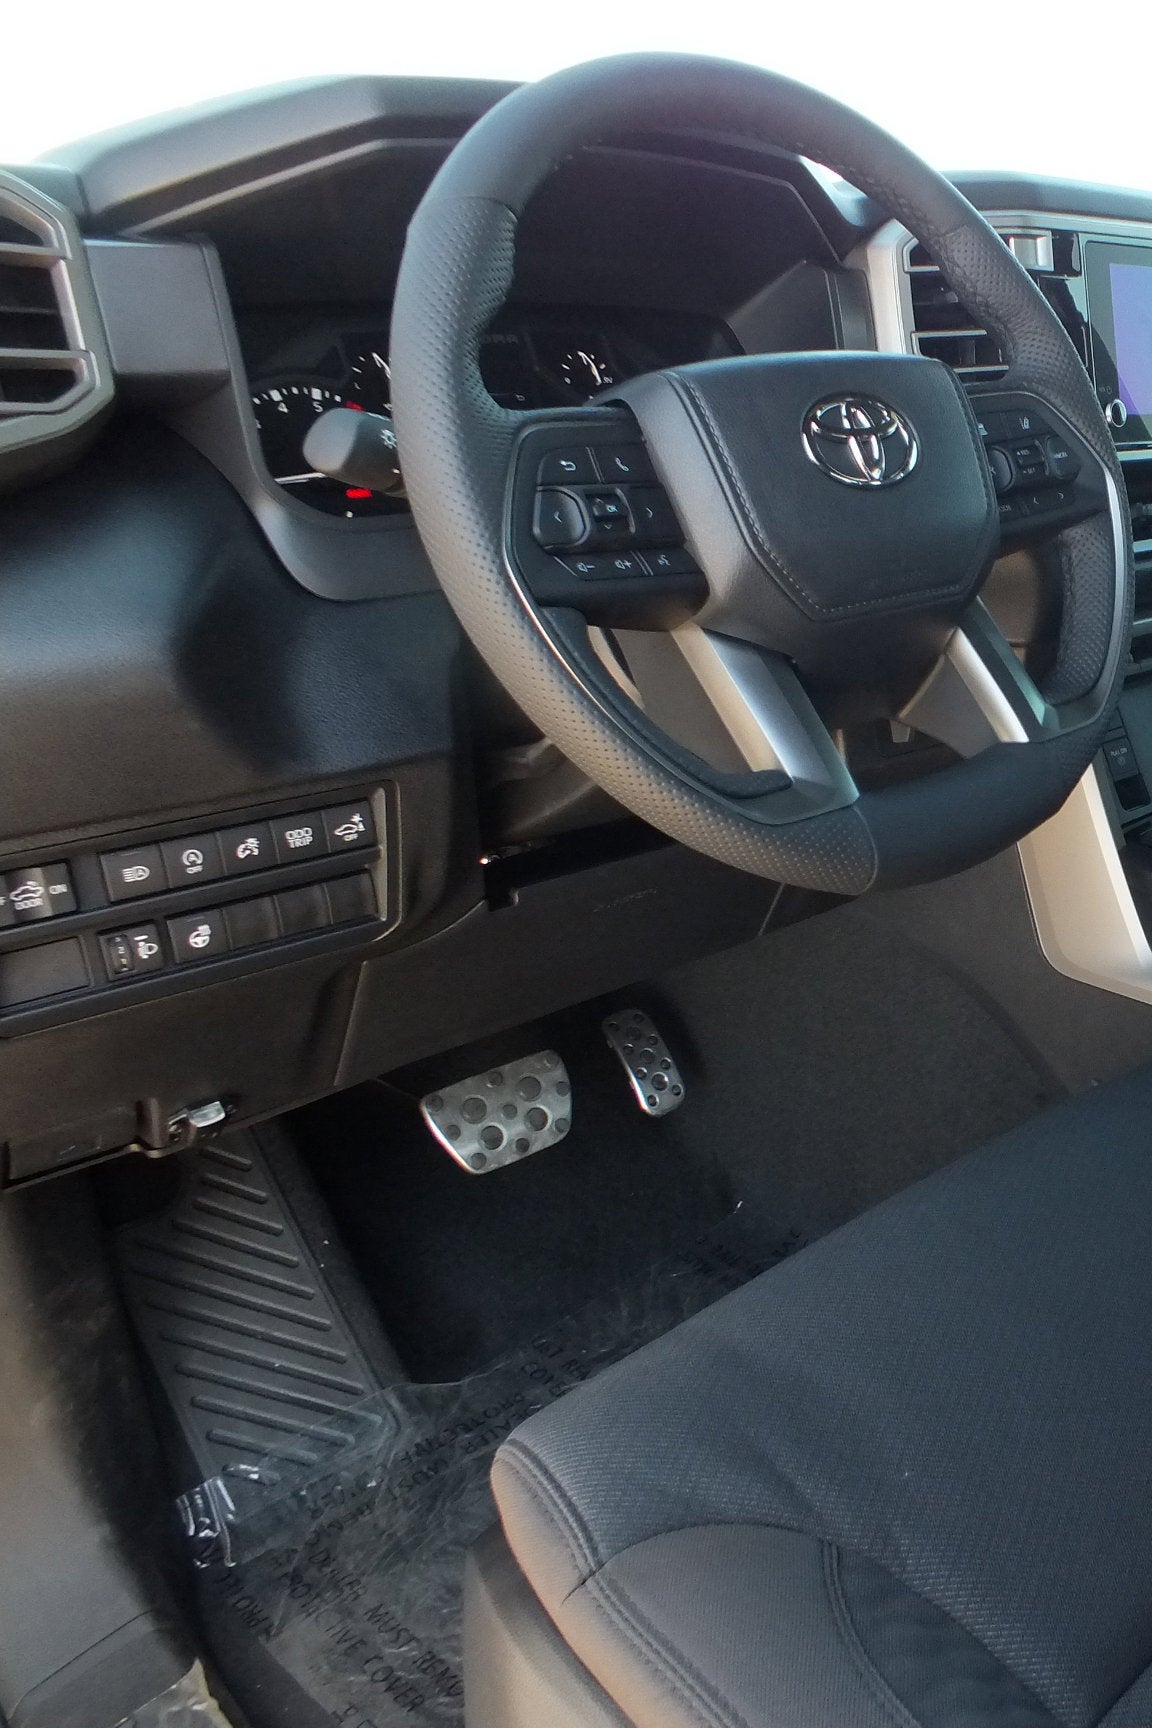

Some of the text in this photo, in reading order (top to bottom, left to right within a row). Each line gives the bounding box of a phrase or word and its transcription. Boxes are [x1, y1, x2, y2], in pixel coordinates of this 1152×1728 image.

[277, 402, 289, 414] 4
[312, 401, 324, 413] 5
[288, 836, 313, 849] TRIP
[49, 884, 68, 895] ON
[15, 898, 44, 910] DOOR
[363, 1603, 420, 1650] MUST
[362, 1654, 425, 1712] COVER
